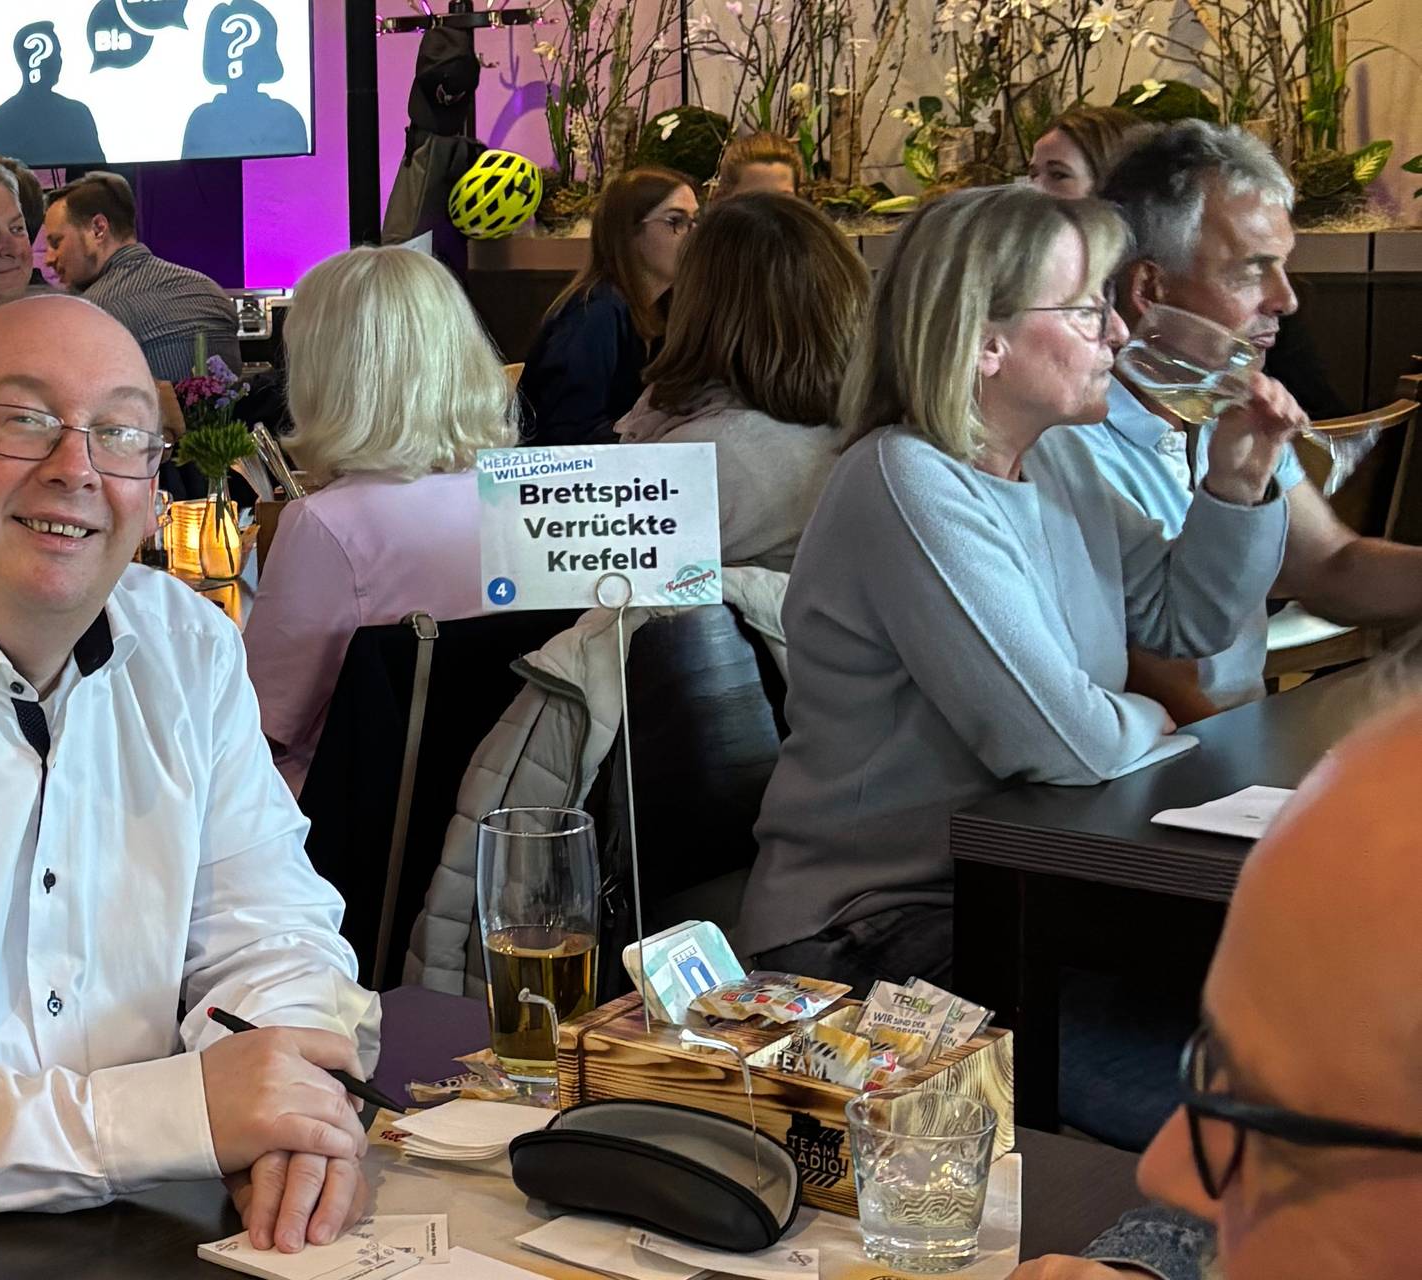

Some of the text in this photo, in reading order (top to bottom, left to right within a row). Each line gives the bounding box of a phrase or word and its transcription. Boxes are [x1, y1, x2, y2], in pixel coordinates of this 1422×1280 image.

[94, 28, 132, 51] Bla
[483, 452, 552, 470] HERZLICH
[494, 458, 593, 480] WILLKOMMEN
[519, 478, 679, 507] Brettspiel-
[524, 513, 677, 539] Verrückte
[548, 546, 658, 572] Krefeld
[495, 583, 508, 598] 4
[873, 1012, 893, 1024] WIR
[912, 1019, 926, 1028] DER
[772, 1050, 826, 1080] TEAM
[788, 1134, 835, 1158] TEAM
[788, 1147, 846, 1177] ADIO!
